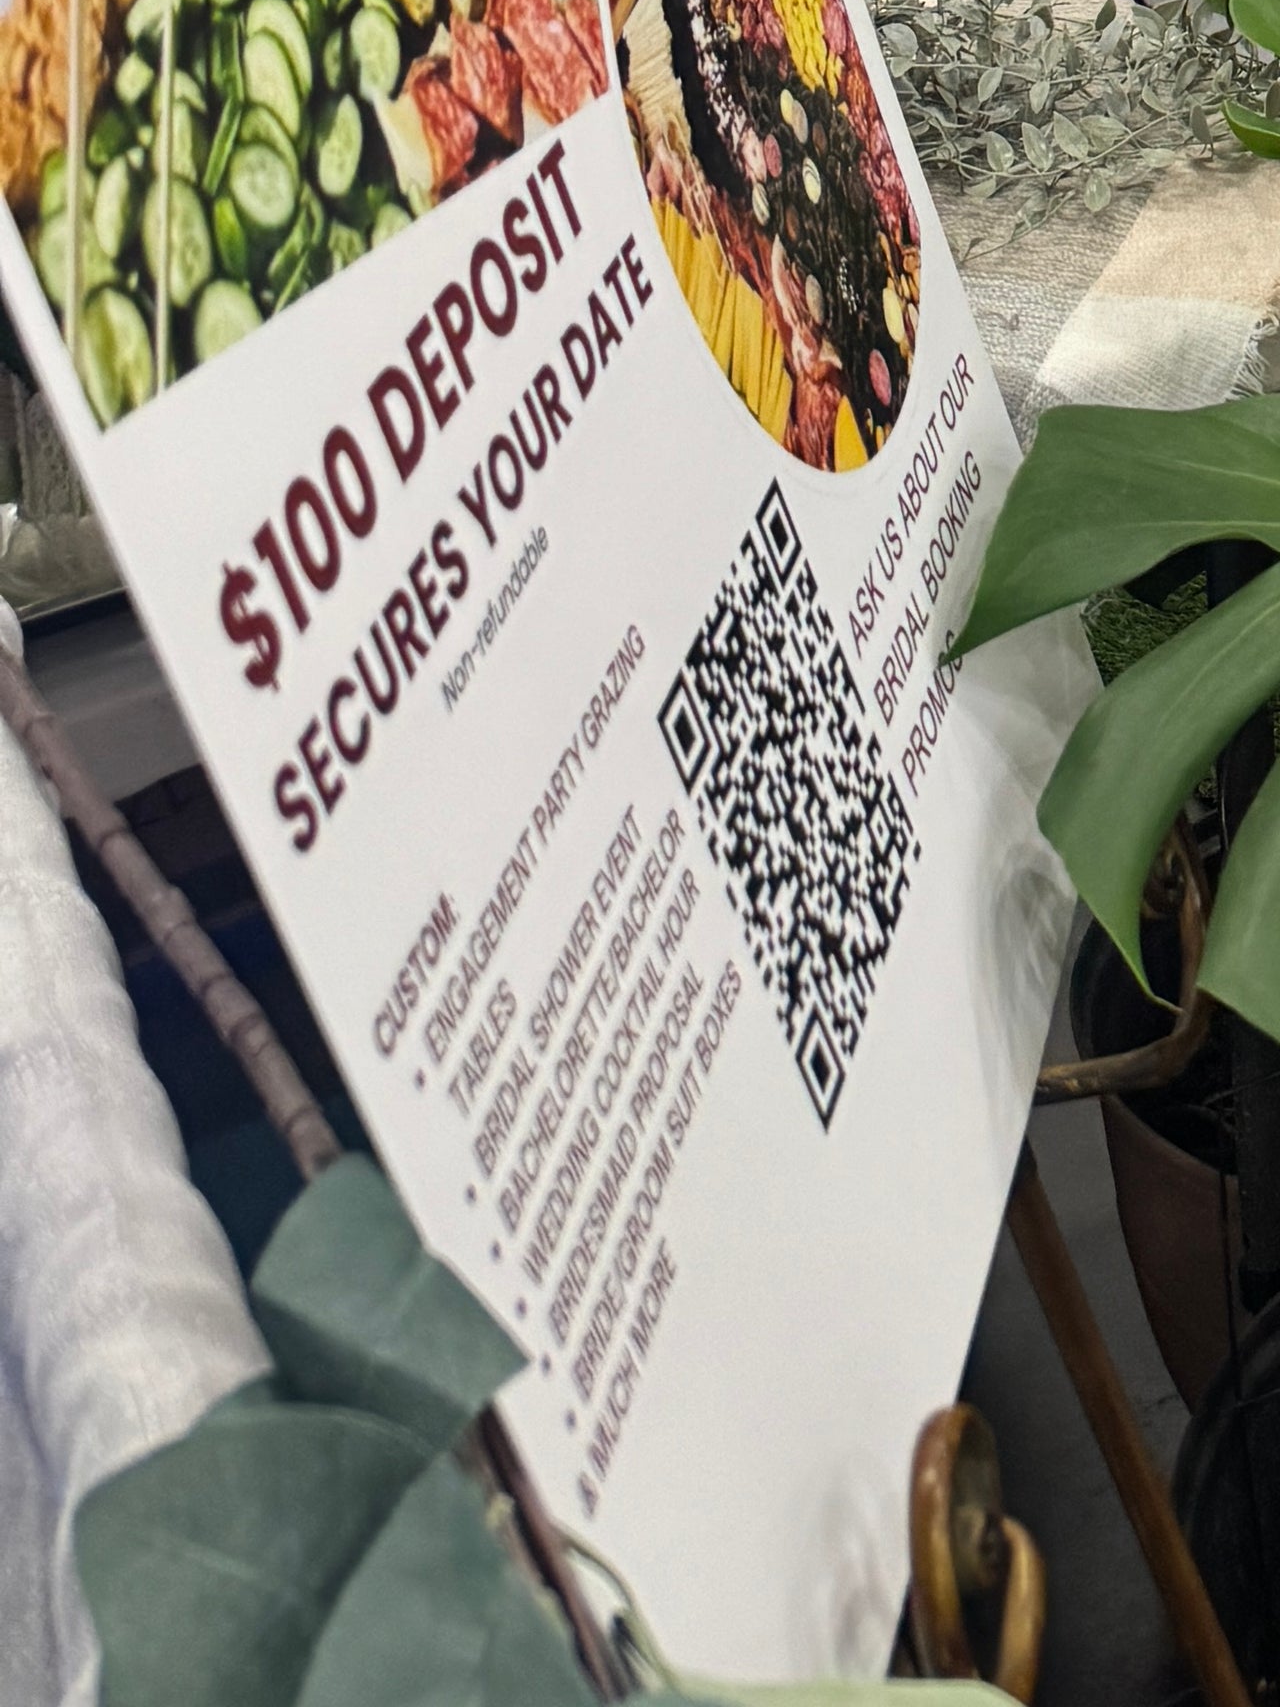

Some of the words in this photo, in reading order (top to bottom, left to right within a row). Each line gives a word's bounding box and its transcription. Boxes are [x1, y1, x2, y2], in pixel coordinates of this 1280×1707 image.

[217, 425, 377, 692] $100
[367, 139, 583, 484] DEPOSIT
[273, 519, 470, 853] SECURES
[458, 364, 573, 549] YOUR
[560, 233, 654, 402] DATE
[847, 560, 886, 660] ASK
[875, 519, 904, 584] US
[898, 412, 950, 545] ABOUT
[939, 351, 975, 432] OUR
[873, 598, 930, 728] BRIDAL
[919, 449, 983, 603] BOOKING
[440, 523, 549, 713] Non-refundable
[373, 891, 461, 1057] CUSTOM:
[425, 827, 540, 1062] ENGAGEMENT
[533, 735, 586, 846] PARTY
[581, 624, 647, 751] GRAZING
[474, 1046, 538, 1179] BRIDAL
[530, 899, 602, 1054] SHOWER
[593, 803, 642, 913] EVENT
[498, 808, 687, 1236] BACHELORETTE/BACHELOR
[448, 978, 518, 1117] TABLES
[521, 1105, 599, 1287] WEDDING
[594, 957, 665, 1118] COCKTAIL
[656, 868, 702, 965] HOUR
[547, 1124, 639, 1348] BRIDESMAID
[630, 959, 704, 1135] PROPOSAL
[571, 1136, 676, 1403] BRIDE/GROOM
[666, 1072, 704, 1148] SUIT
[694, 960, 742, 1077] BOXES
[586, 1347, 641, 1483] MUCH
[629, 1237, 678, 1361] MORE
